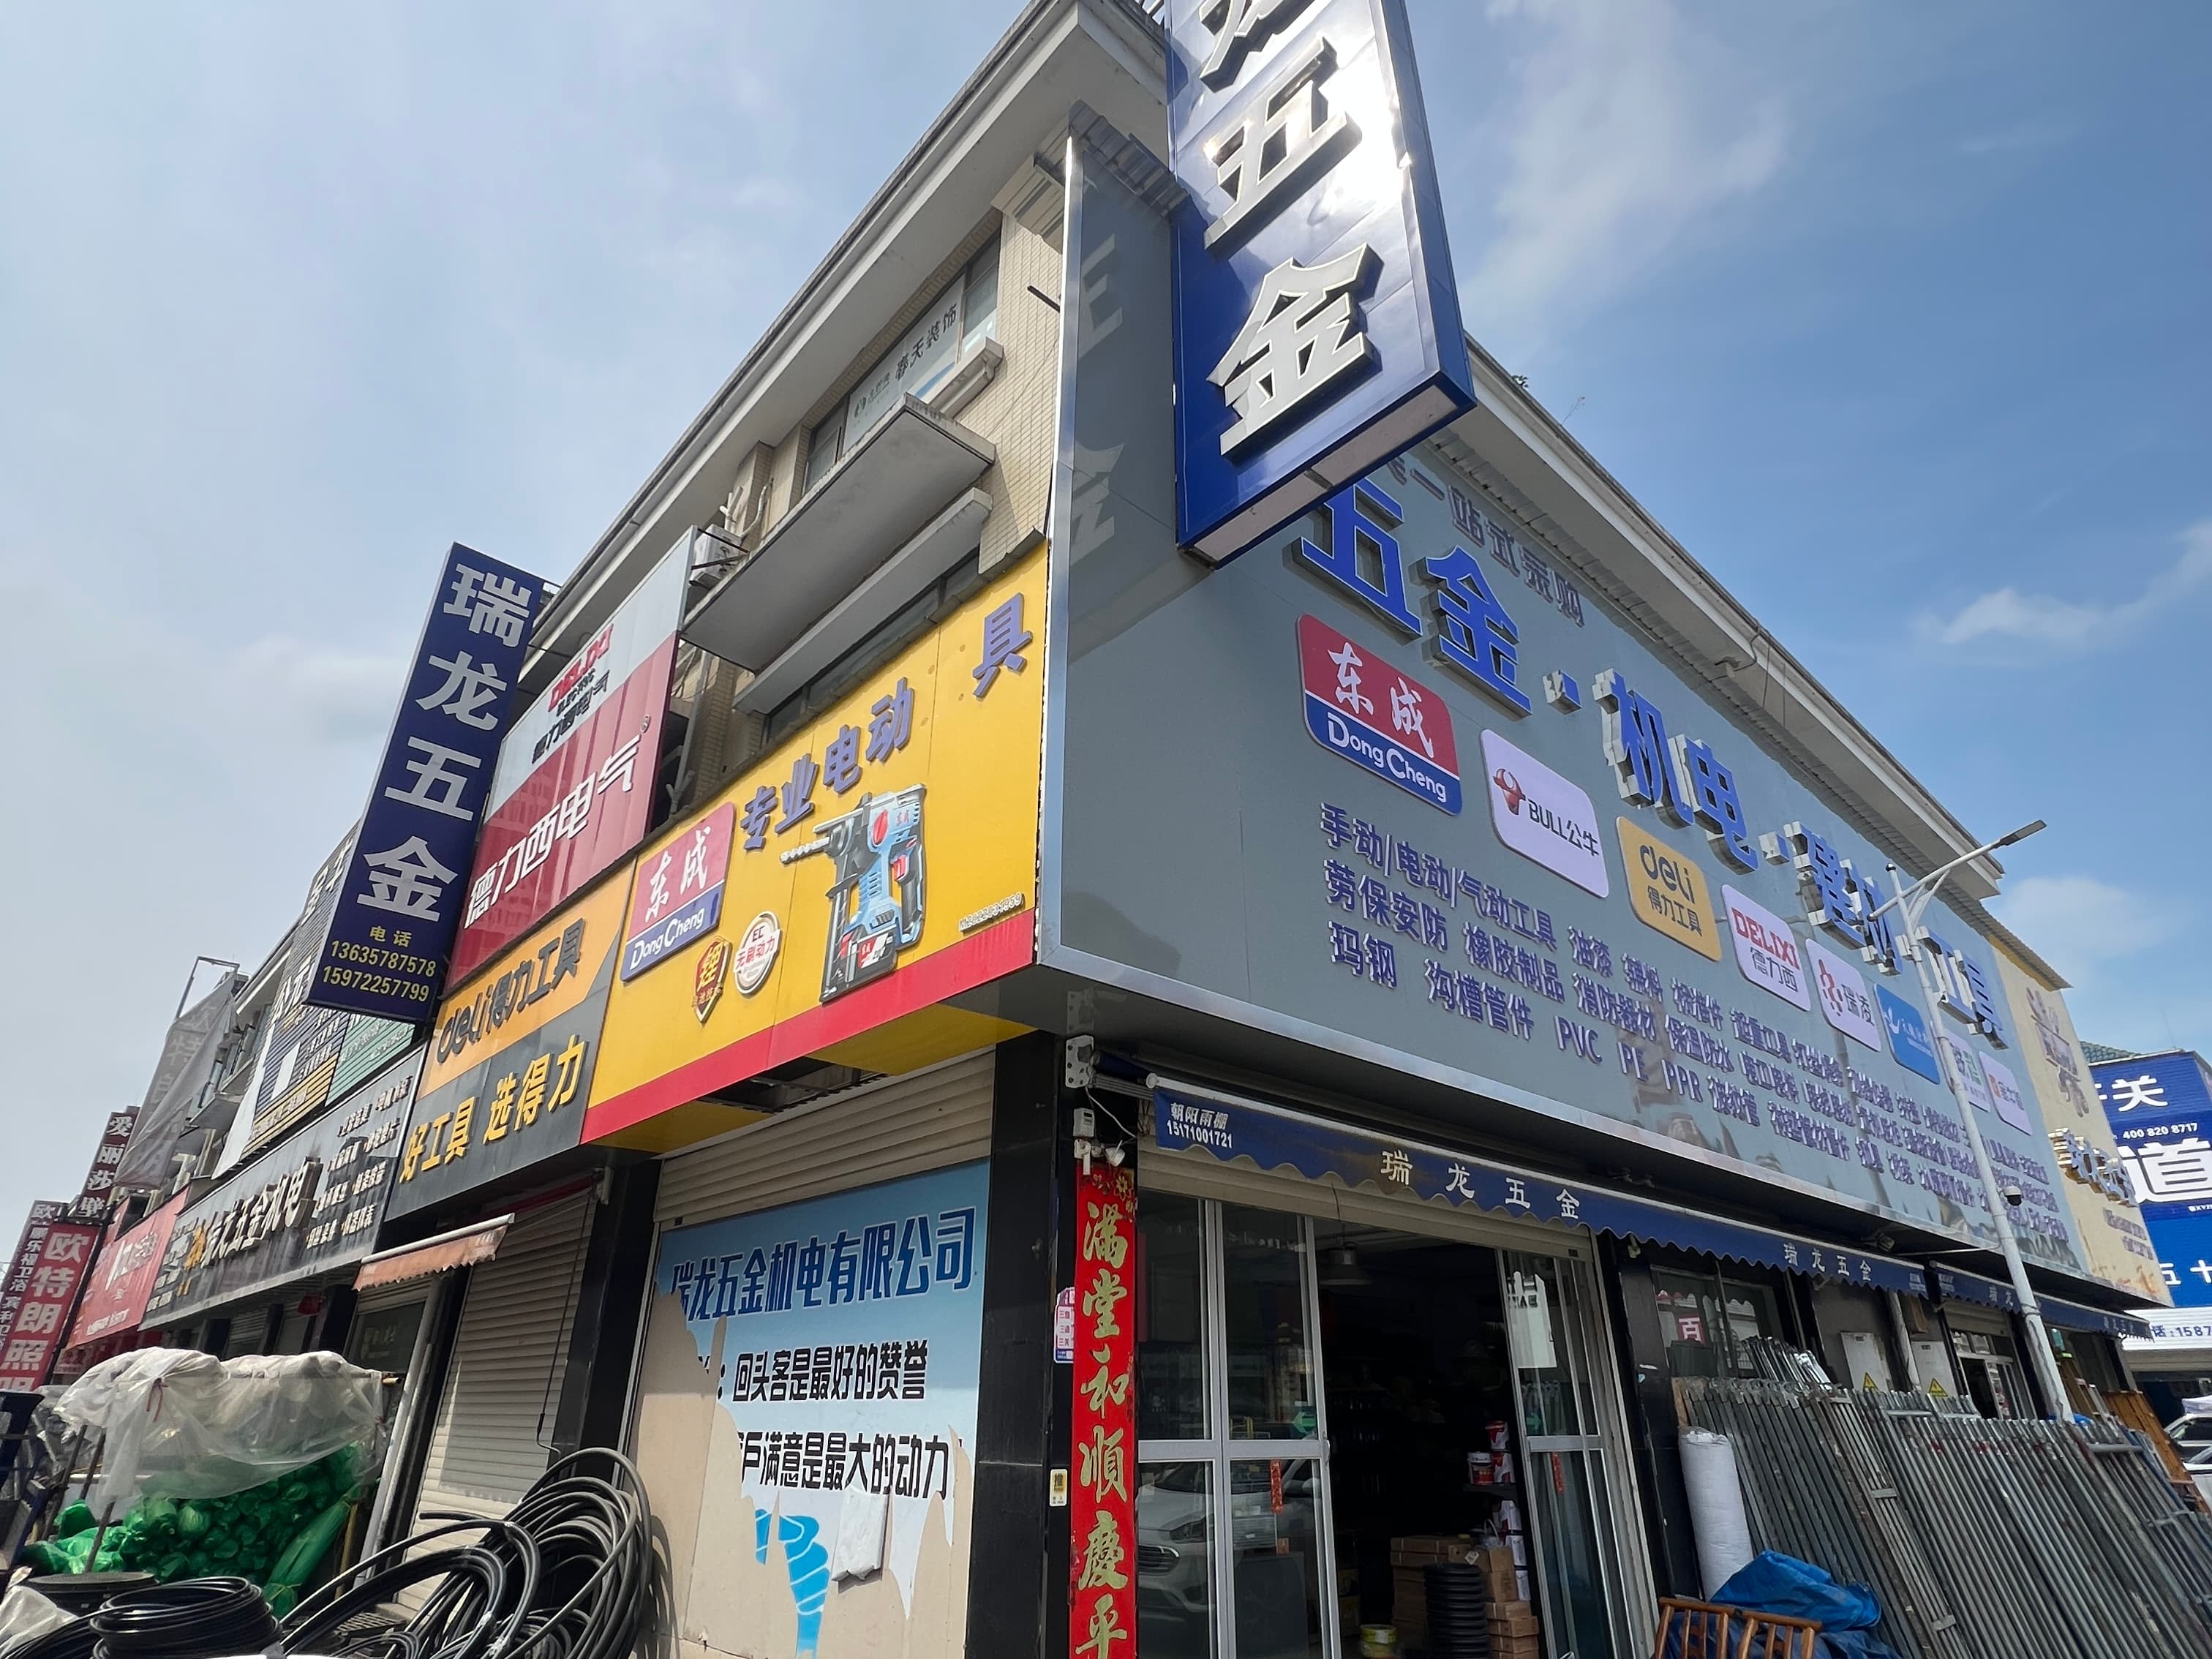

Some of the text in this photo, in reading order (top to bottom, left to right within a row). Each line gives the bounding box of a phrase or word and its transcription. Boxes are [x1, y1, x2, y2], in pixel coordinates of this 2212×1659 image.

[740, 592, 1032, 851] 专业电动 具
[1327, 642, 1434, 758] 东成
[356, 563, 531, 922] 瑞龙五金
[1327, 712, 1446, 802] DongCheng
[464, 734, 640, 929] 德力西电气
[645, 825, 711, 924] 东成
[1639, 843, 1696, 905] deli
[371, 925, 412, 948] 电话
[1647, 884, 1703, 938] 得力工具
[1731, 907, 1799, 970] DELIXI
[331, 940, 436, 978] 13635787578
[735, 936, 775, 969] 无刷动力
[1323, 859, 1448, 952] 劳保安防
[1464, 922, 1565, 1004] 橡胶制品
[1573, 972, 1657, 1042] 消防器材
[1568, 925, 1613, 978] 油漆
[1749, 947, 1799, 994] 德力西
[323, 965, 430, 1002] 15972257799
[1328, 921, 1398, 988] 玛钢
[1424, 958, 1534, 1041] 沟槽管件
[1555, 1015, 1602, 1064] PVC
[1617, 1040, 1648, 1082] PE
[1661, 1059, 1703, 1103] PPR
[399, 1096, 475, 1184] 好工具
[484, 1034, 585, 1146] 选得力
[1170, 1102, 1229, 1130] 朝阳雨棚
[2094, 1075, 2168, 1112] 关
[1167, 1119, 1233, 1148] 15171001721
[2123, 1123, 2198, 1140] 400 820 8717
[1380, 1149, 1581, 1229] 瑞龙五金
[2115, 1137, 2212, 1203] 道
[671, 1206, 977, 1322] 瑞龙五金机电有限公司
[1783, 1243, 1871, 1281] 瑞龙五金
[731, 1339, 929, 1403] 回头客是最好的赞誉
